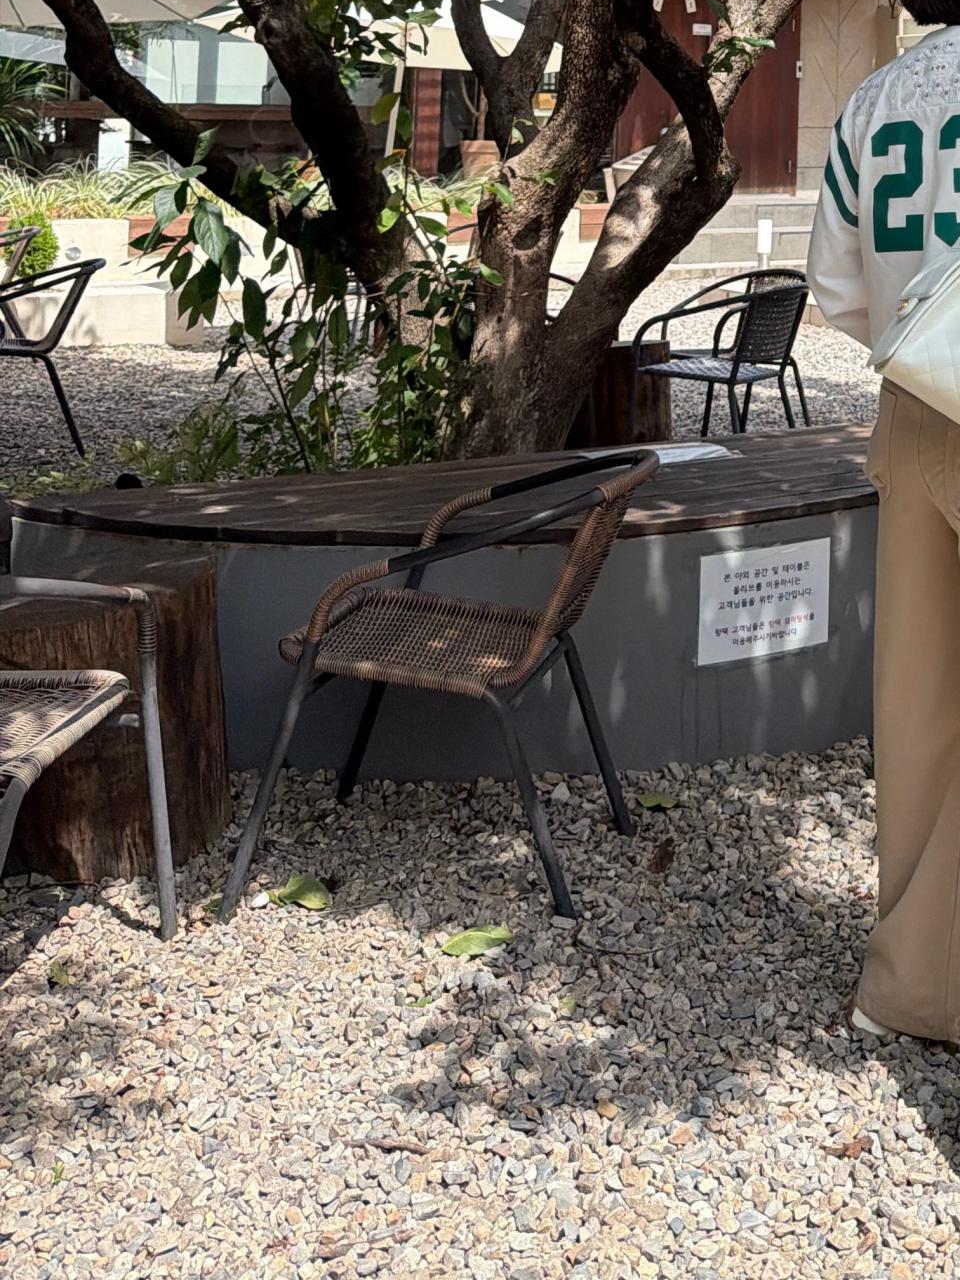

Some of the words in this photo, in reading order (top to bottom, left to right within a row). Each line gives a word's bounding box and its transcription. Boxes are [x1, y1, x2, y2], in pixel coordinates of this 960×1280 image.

[723, 573, 731, 583] 본
[735, 570, 750, 581] 야외
[754, 567, 769, 579] 공간
[771, 566, 779, 575] 및
[782, 560, 810, 573] 테이블은
[733, 582, 762, 596] 올리브를
[766, 576, 801, 589] 이용하시는
[718, 596, 756, 610] 고객님들을
[759, 594, 774, 605] 위한
[777, 587, 812, 602] 공간입니다
